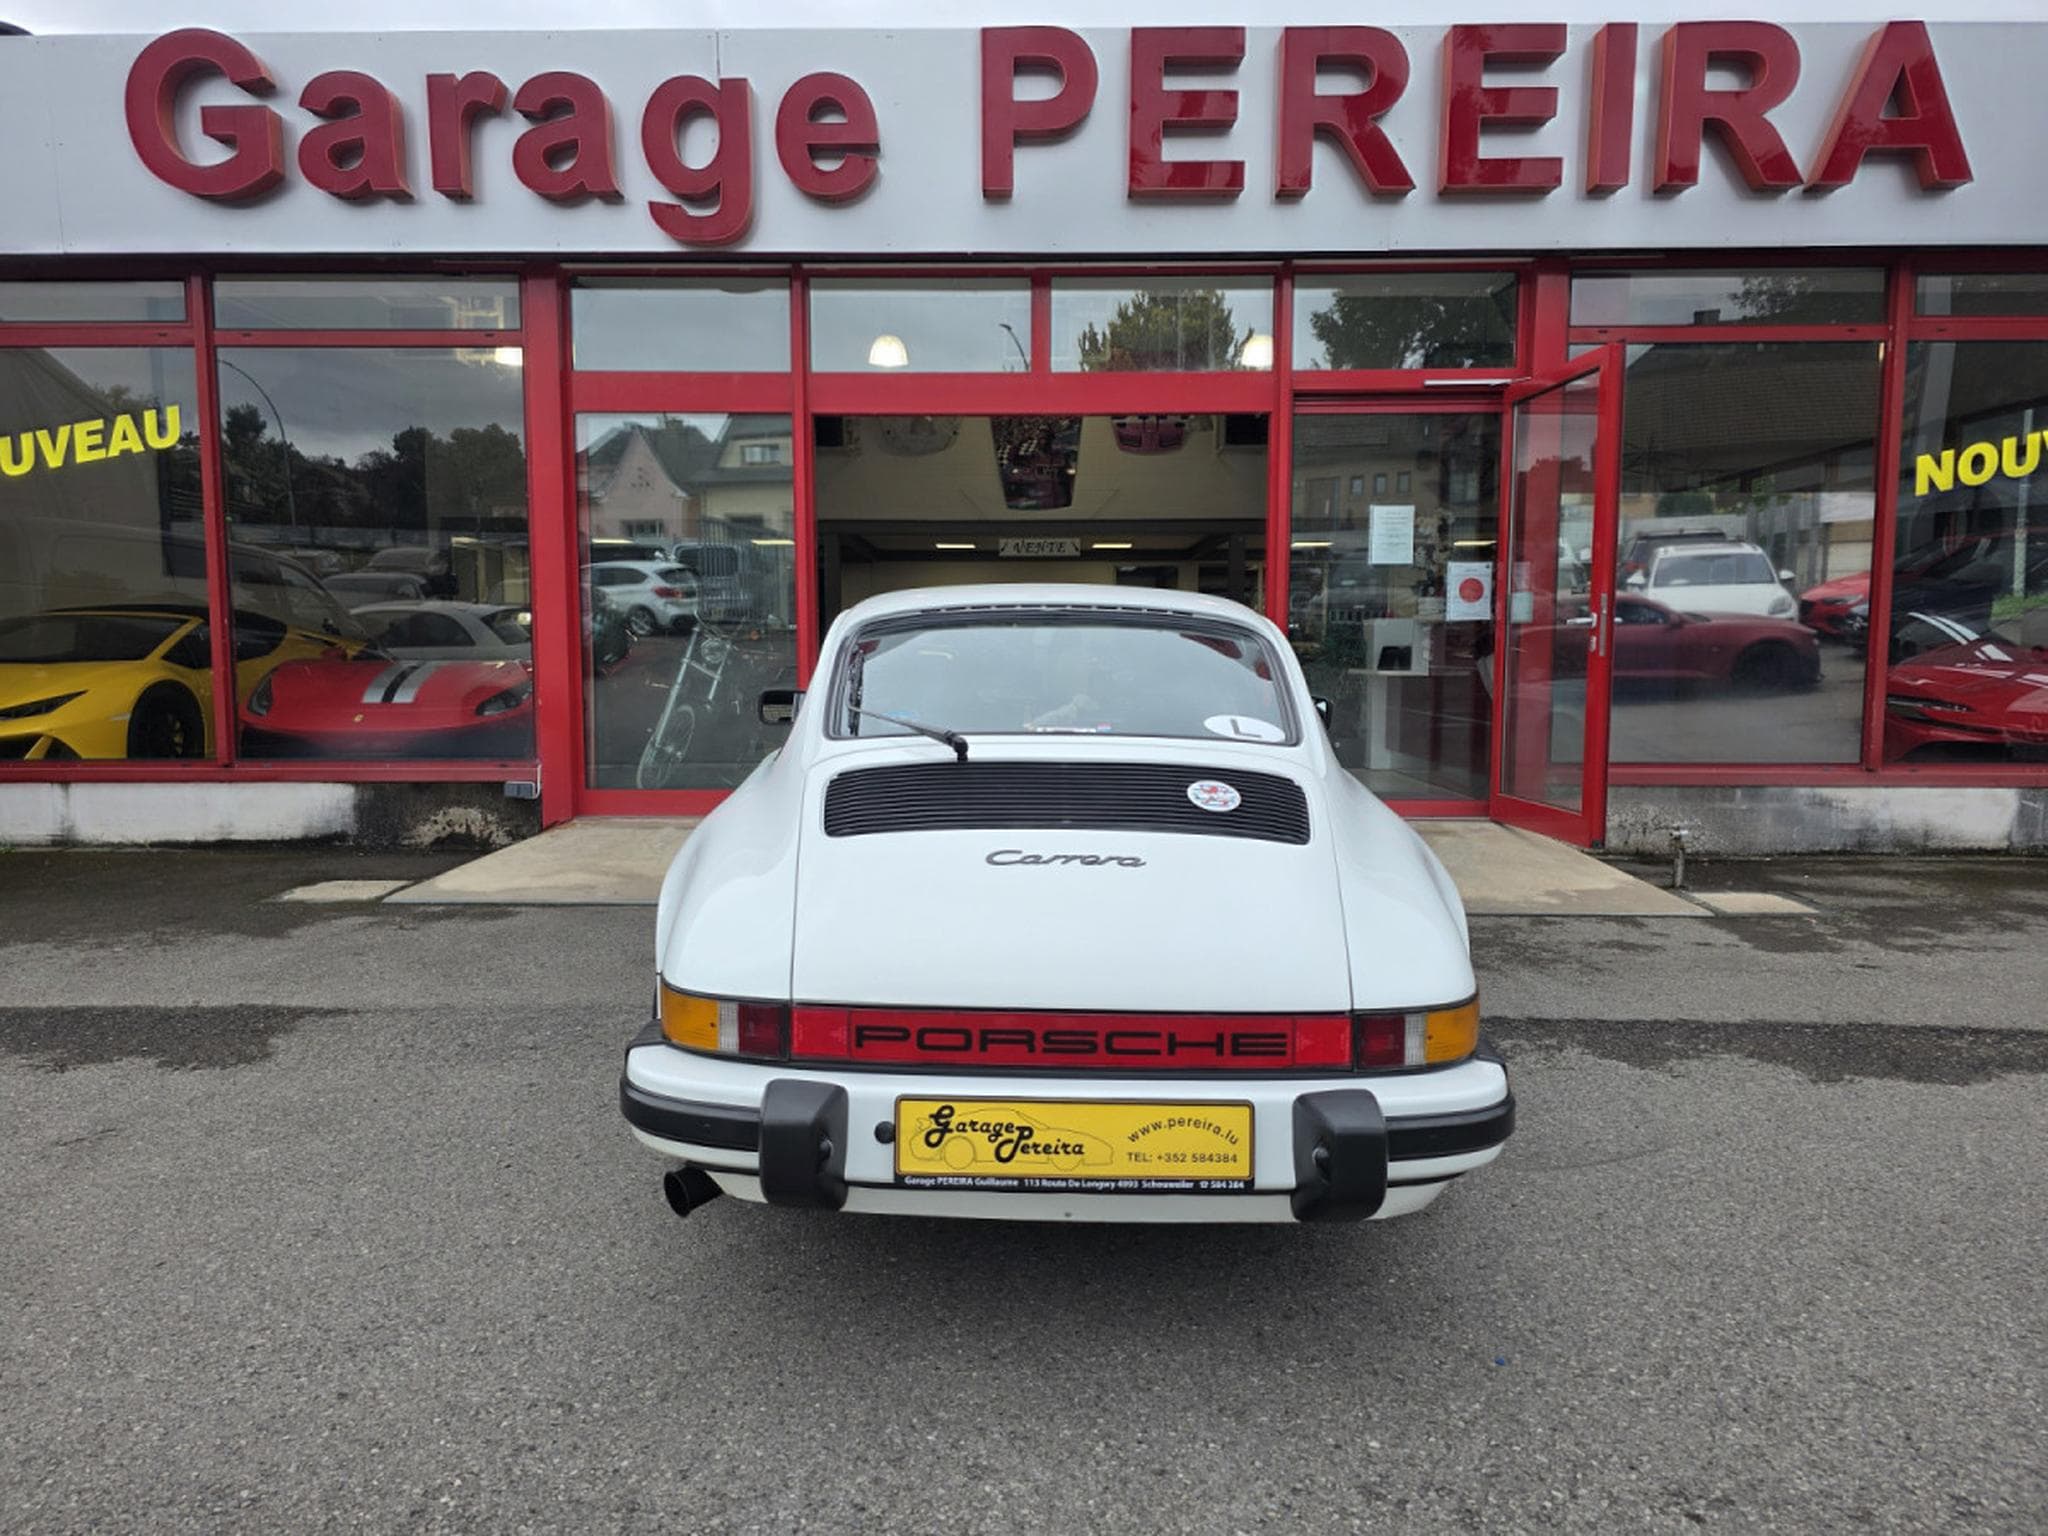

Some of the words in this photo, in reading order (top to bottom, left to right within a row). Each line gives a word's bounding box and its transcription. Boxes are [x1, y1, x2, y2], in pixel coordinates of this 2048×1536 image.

[125, 28, 880, 247] Garage
[980, 20, 1974, 200] PEREIRA
[0, 405, 181, 477] UVEAU
[1914, 429, 2048, 497] NOU
[1230, 717, 1263, 738] L
[985, 849, 1147, 868] Carrera
[855, 1024, 1288, 1057] PORSCHE
[924, 1104, 1015, 1149] Garage
[1127, 1116, 1239, 1145] www.pereira.lu
[994, 1125, 1084, 1164] Pereira
[1127, 1151, 1153, 1163] TEL:
[1157, 1152, 1187, 1163] +352
[1191, 1152, 1238, 1163] 584384
[904, 1175, 936, 1187] Garage
[937, 1176, 974, 1187] PEREIRA
